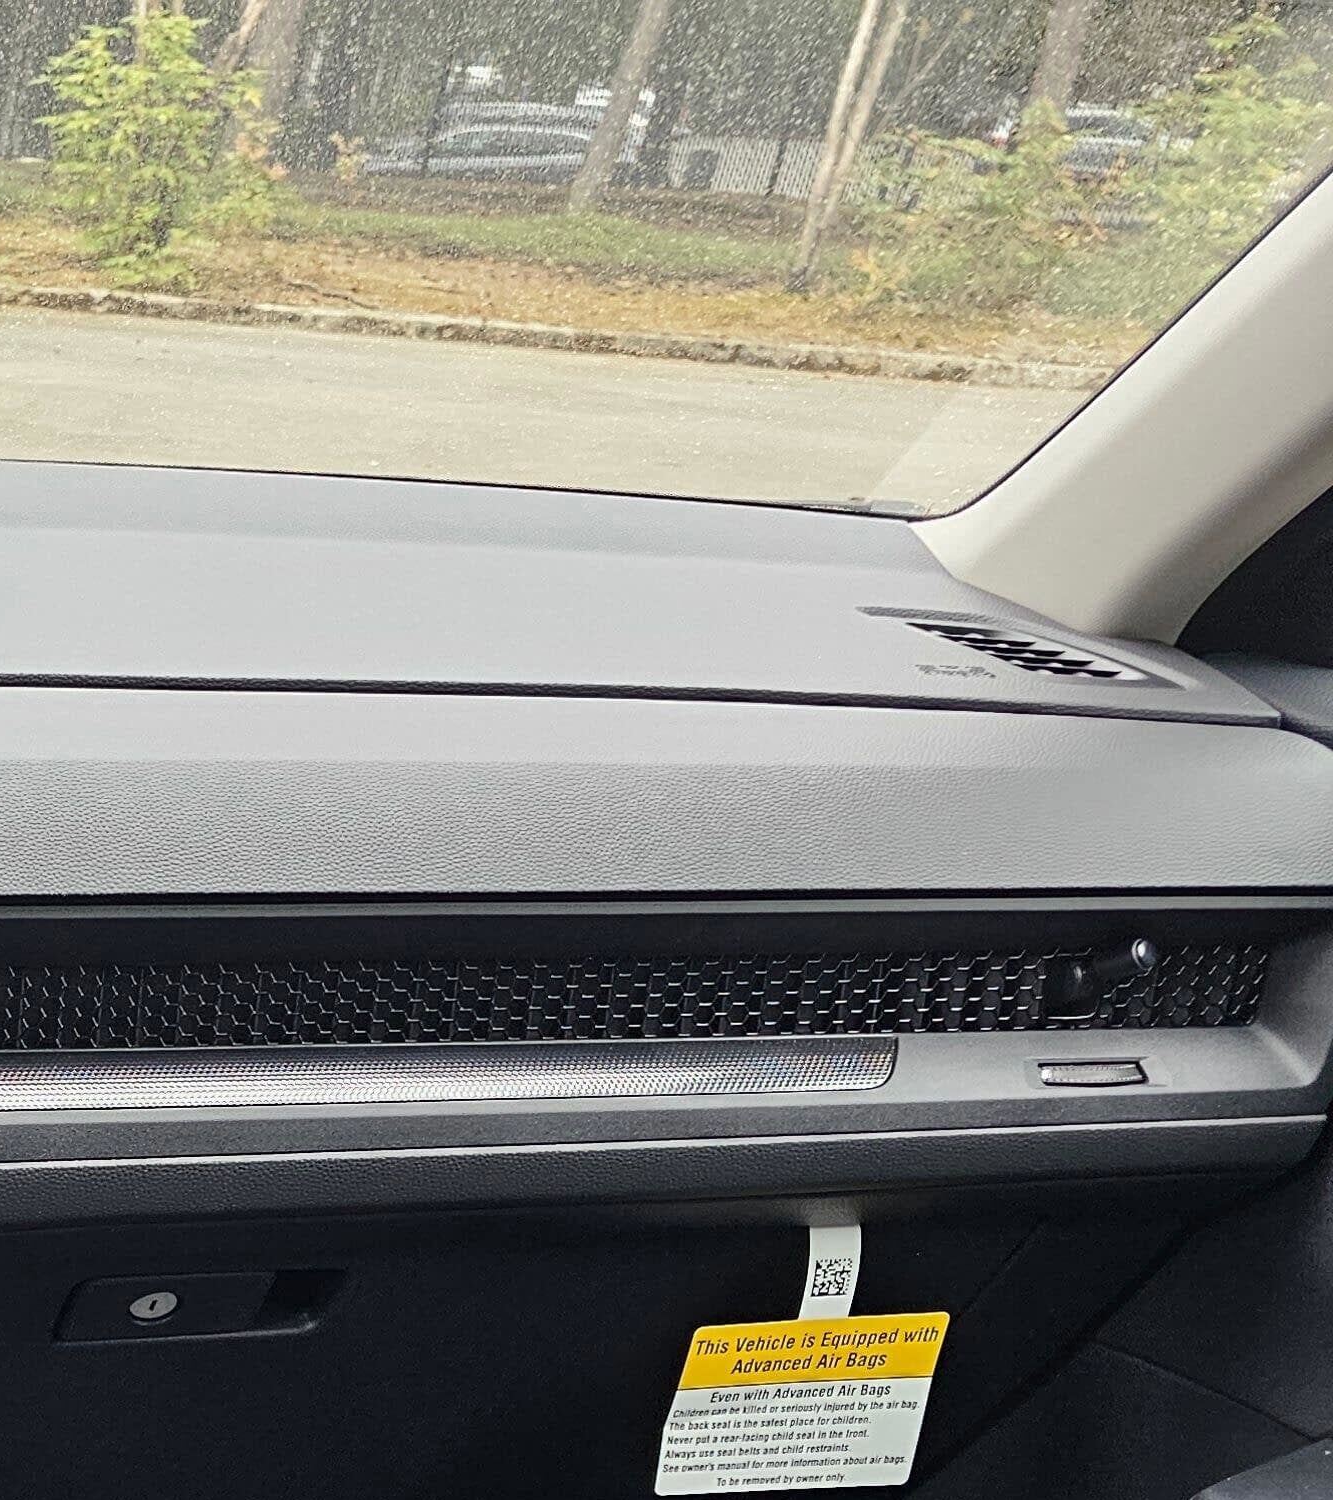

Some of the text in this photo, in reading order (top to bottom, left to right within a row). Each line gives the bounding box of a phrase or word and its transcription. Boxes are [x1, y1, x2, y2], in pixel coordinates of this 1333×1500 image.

[696, 1326, 939, 1355] This Vehicle is Equipped with
[731, 1352, 888, 1375] Advanced Air Bags
[710, 1384, 892, 1403] Even with Advanced Air Bags
[673, 1408, 710, 1419] Children
[711, 1407, 727, 1416] can
[729, 1406, 741, 1415] be
[742, 1404, 768, 1414] killed
[769, 1405, 779, 1413] or
[781, 1403, 822, 1414] seriously
[823, 1402, 856, 1412] injured
[857, 1402, 869, 1412] by
[870, 1400, 884, 1410] the
[886, 1400, 900, 1409] air
[669, 1416, 872, 1431] The back seat is the safest place for children.
[667, 1436, 693, 1445] Never
[695, 1435, 710, 1446] put
[720, 1433, 770, 1444] rear-facing
[771, 1431, 794, 1441] child
[796, 1430, 816, 1440] seat
[817, 1430, 827, 1440] in
[829, 1430, 844, 1439] the
[664, 1450, 696, 1460] Always
[699, 1450, 714, 1458] use
[717, 1448, 736, 1457] seat
[738, 1447, 761, 1456] belts
[762, 1446, 780, 1455] and
[782, 1445, 804, 1454] child
[662, 1464, 679, 1473] See
[681, 1462, 714, 1472] owner's
[717, 1461, 750, 1470] manual
[752, 1460, 764, 1469] for
[766, 1459, 788, 1468] more
[791, 1457, 841, 1467] information
[843, 1456, 868, 1466] about
[869, 1456, 882, 1465] air
[716, 1477, 727, 1487] To
[728, 1477, 740, 1486] be
[741, 1475, 781, 1485] removed
[783, 1475, 794, 1486] by
[796, 1474, 824, 1483] owner
